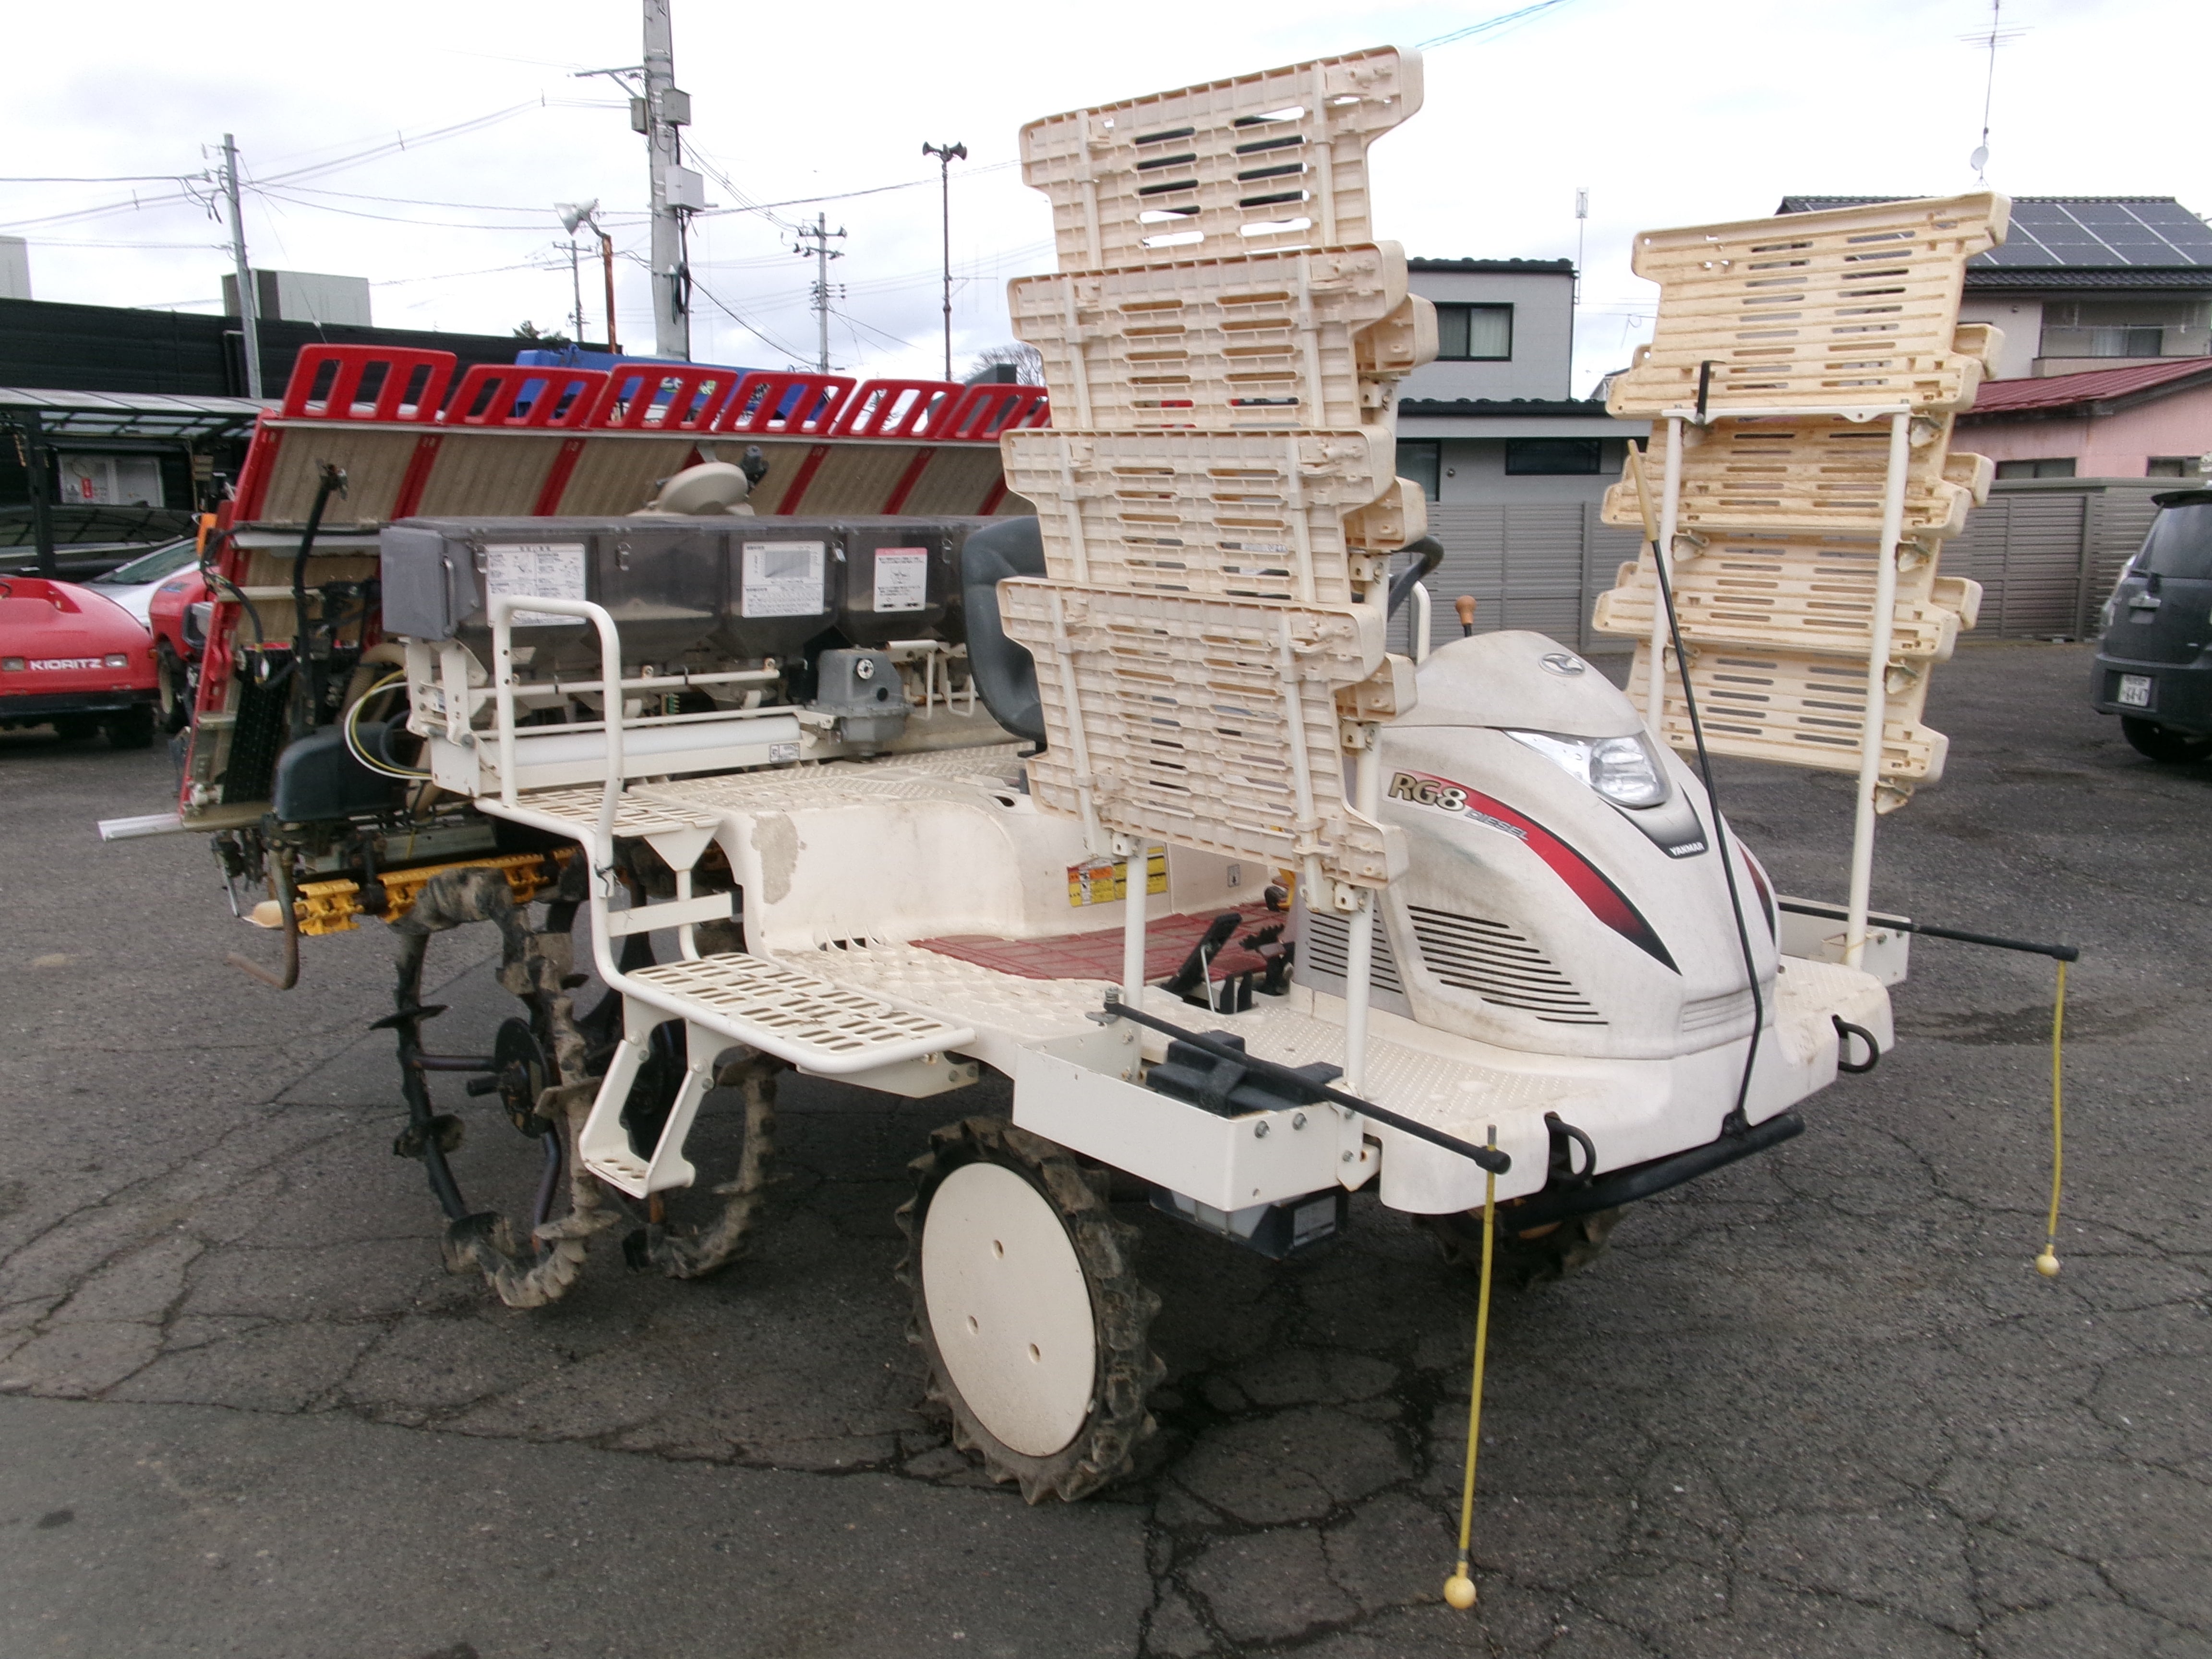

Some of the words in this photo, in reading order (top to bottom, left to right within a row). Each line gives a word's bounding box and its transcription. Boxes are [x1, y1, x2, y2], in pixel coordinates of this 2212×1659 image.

[30, 658, 102, 671] KIORITZ
[1388, 772, 1468, 811] RG8
[1464, 809, 1528, 841] DIESEL
[1669, 842, 1705, 856] YANMAR
